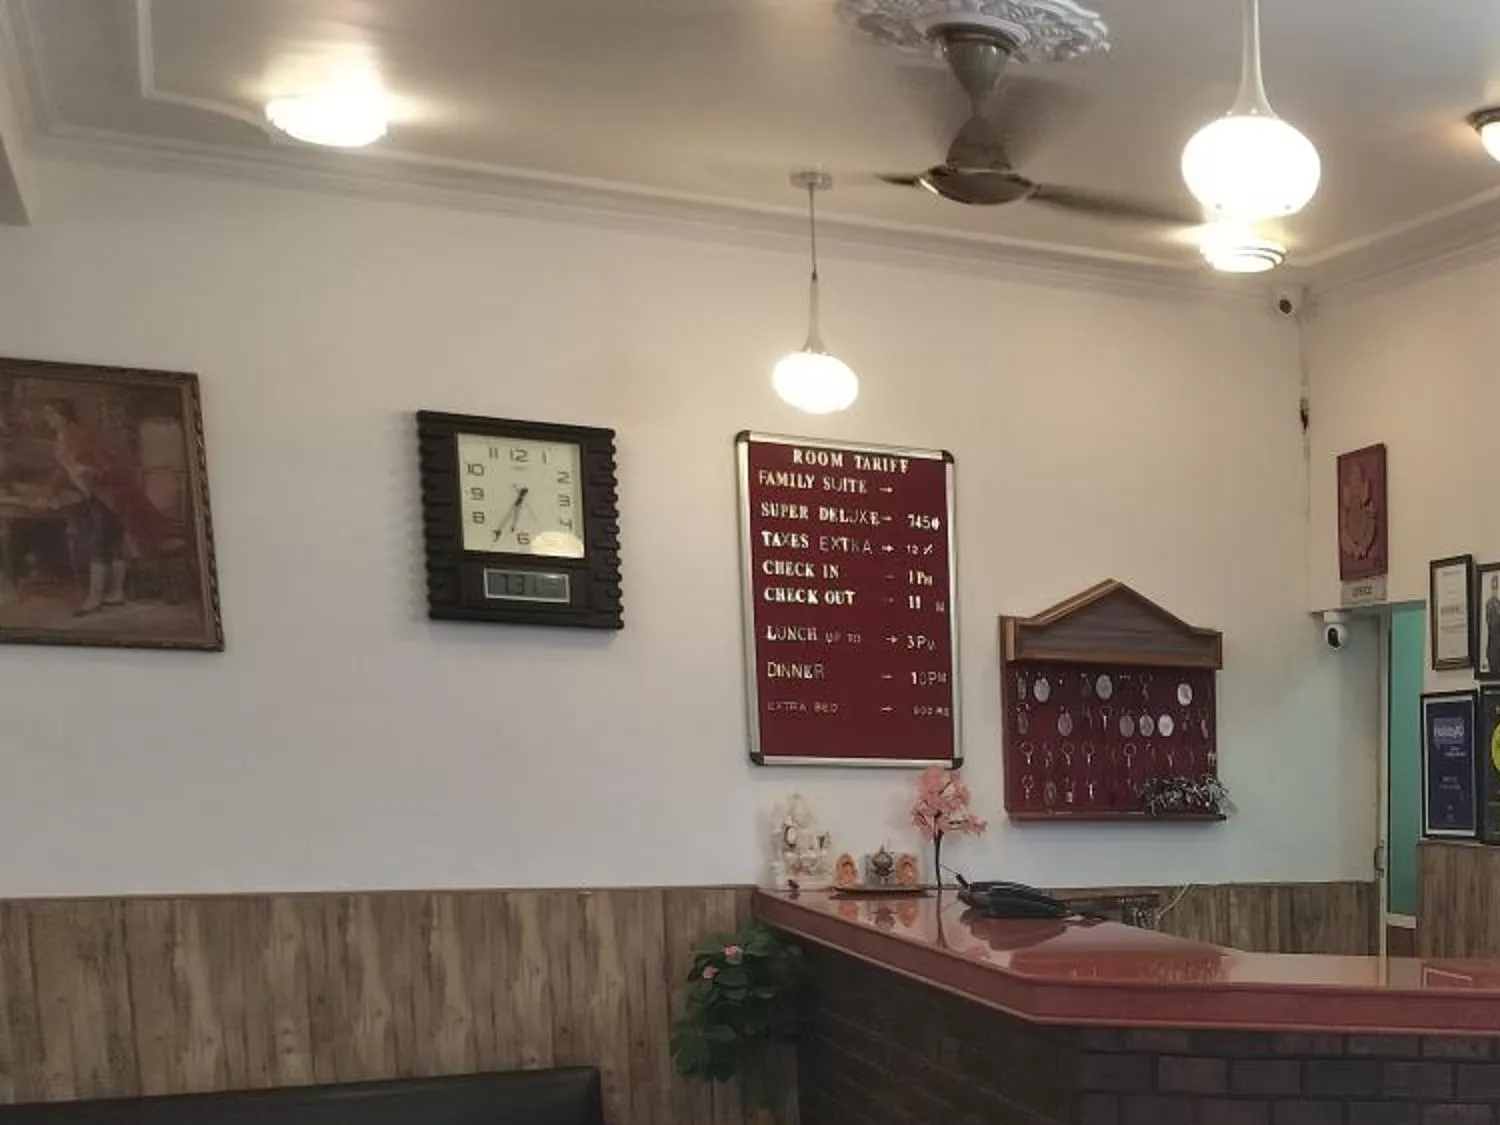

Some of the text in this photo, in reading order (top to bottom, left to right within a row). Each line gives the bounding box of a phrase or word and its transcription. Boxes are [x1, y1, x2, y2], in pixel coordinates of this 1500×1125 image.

[488, 447, 499, 460] 11
[509, 448, 529, 462] 12
[793, 447, 909, 474] ROOM TARIFF
[467, 463, 485, 477] 10
[557, 471, 571, 484] 2
[759, 469, 868, 494] FAMILY SUITE
[470, 487, 485, 501] 9
[472, 511, 486, 525] 8
[760, 501, 809, 520] SUPER
[819, 505, 881, 526] DELUXE
[517, 532, 530, 545] 6
[761, 530, 809, 549] TAXES
[819, 534, 873, 555] EXTRA
[763, 559, 815, 578] CHECK
[823, 563, 840, 579] IN
[764, 586, 819, 605] CHECK
[824, 588, 856, 606] OUT
[767, 623, 817, 642] LUNCH
[767, 660, 825, 679] DINNER
